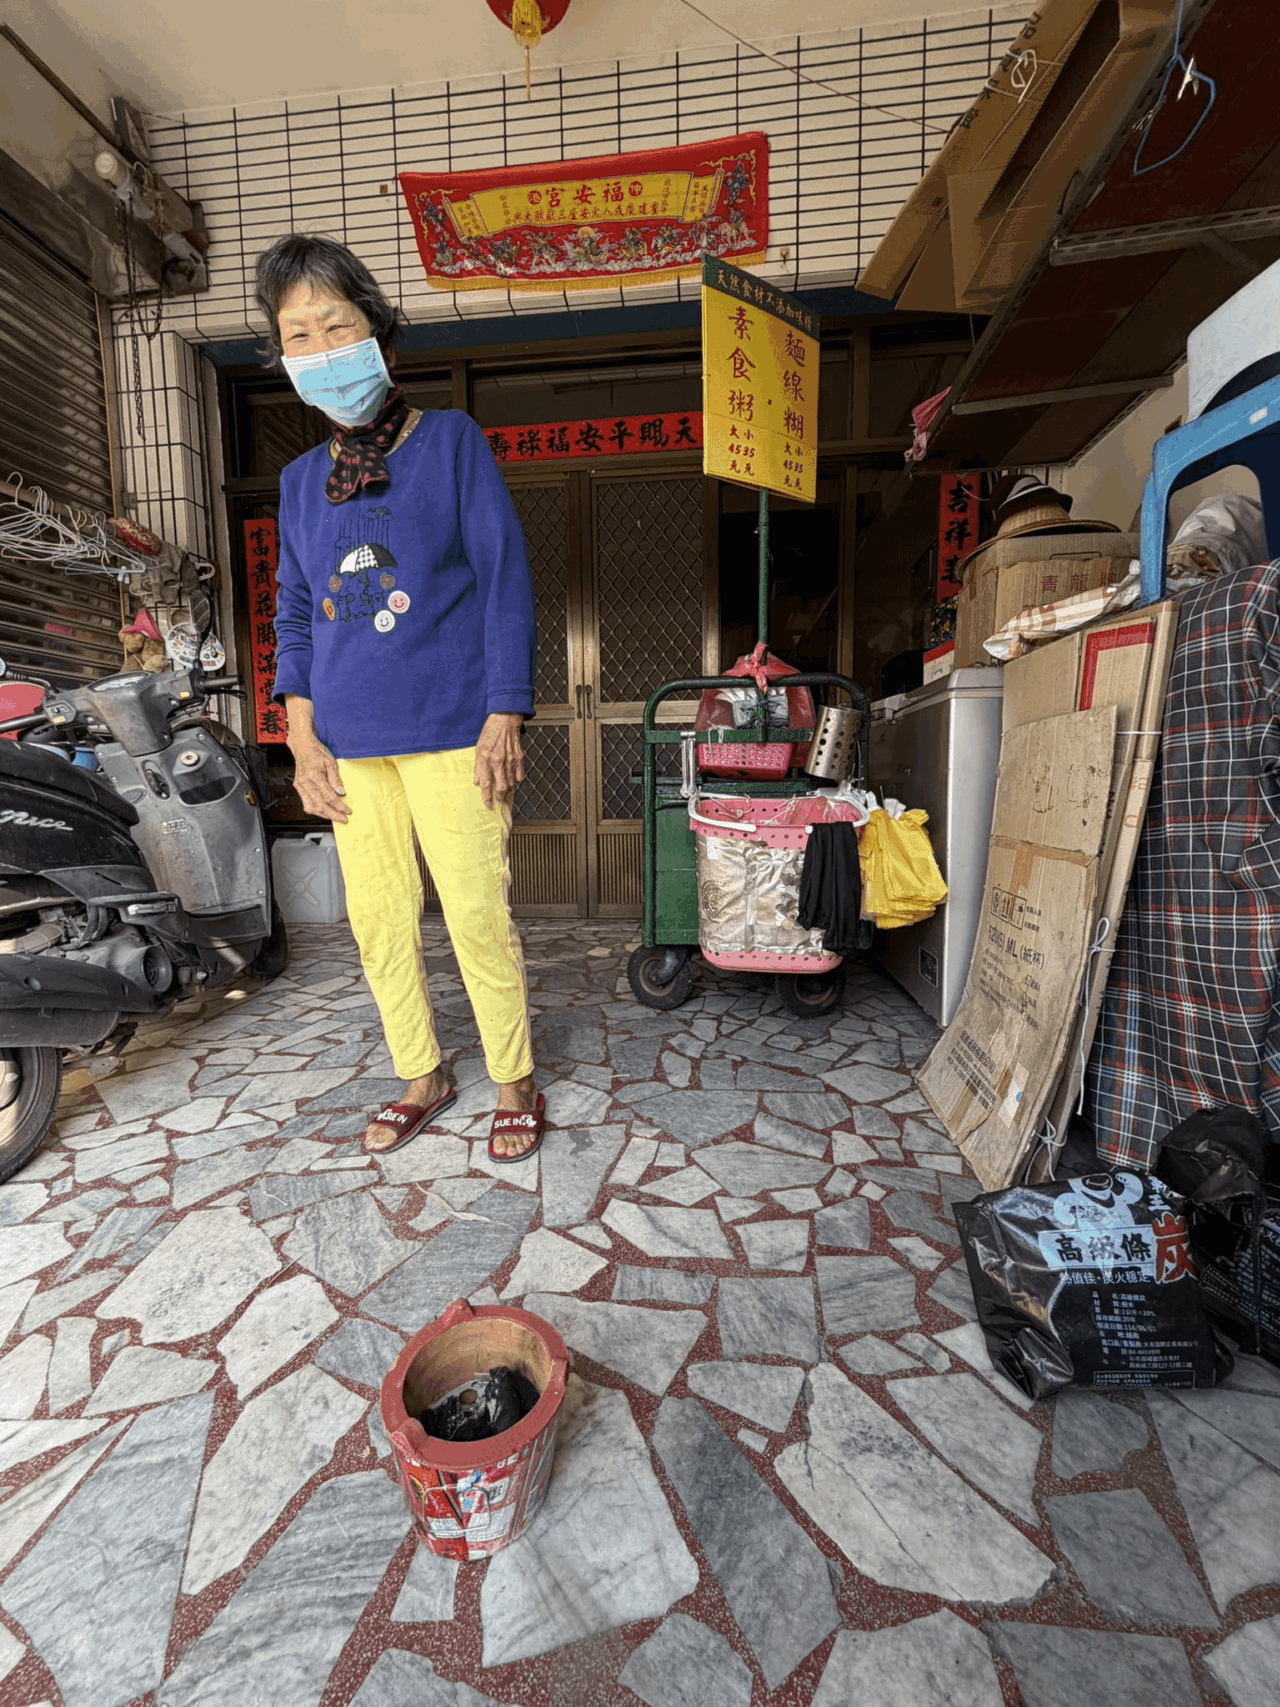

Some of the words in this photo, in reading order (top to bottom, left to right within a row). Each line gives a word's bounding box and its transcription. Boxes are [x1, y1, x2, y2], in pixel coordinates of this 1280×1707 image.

[726, 306, 756, 422] 素食粥
[783, 331, 806, 440] 麵線糊
[494, 1118, 511, 1128] SUE
[513, 1117, 522, 1125] IN
